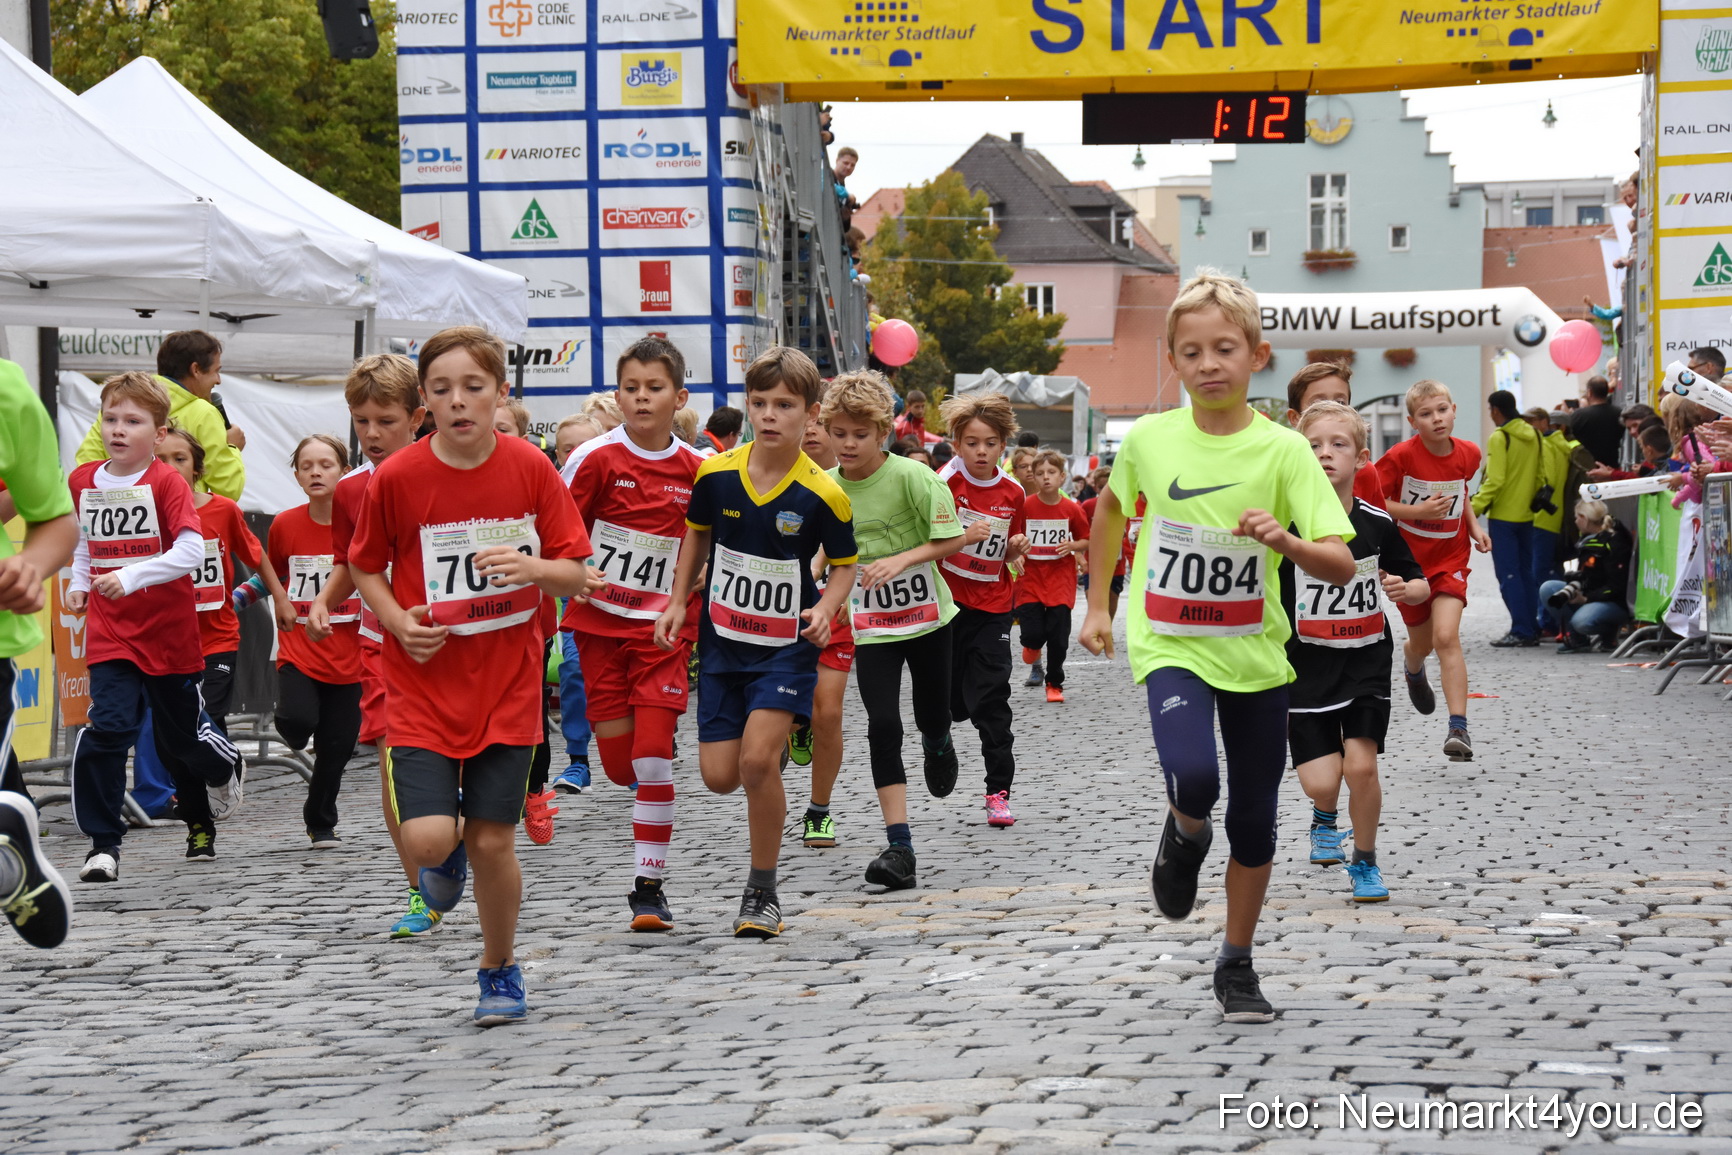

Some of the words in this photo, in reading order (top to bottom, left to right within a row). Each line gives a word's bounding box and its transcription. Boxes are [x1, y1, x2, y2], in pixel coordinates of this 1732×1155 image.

[538, 3, 570, 14] CODE
[1400, 6, 1512, 24] Neumarkter
[1515, 1, 1601, 19] Stadtlauf
[538, 14, 576, 26] CLINIC
[602, 12, 671, 24] RAIL.ONE
[786, 26, 890, 41] Neumarkter
[895, 24, 977, 40] Stadtlauf
[490, 75, 538, 86] Neumarkter
[539, 73, 573, 86] Tagblatt
[626, 65, 678, 87] Burgis
[1214, 96, 1290, 139] 1:12
[510, 146, 581, 160] VARIOTEC
[418, 161, 462, 174] energie
[656, 157, 702, 168] energie
[1694, 191, 1732, 205] VARI
[606, 208, 677, 224] charivari
[640, 289, 669, 303] Braun
[1261, 306, 1341, 330] BMW
[1351, 304, 1502, 334] Laufsport
[532, 366, 570, 374] neumarkt
[614, 479, 636, 488] JAKO
[1431, 482, 1459, 490] BOCK
[106, 489, 146, 501] BOCK
[722, 508, 740, 518] JAKO
[86, 506, 151, 537] 7022
[432, 538, 470, 548] NeuerMarkt
[476, 522, 530, 542] BOCK
[634, 534, 674, 551] BOCK
[1030, 529, 1066, 544] 7128
[93, 542, 151, 557] Jamie-Leon
[436, 544, 532, 594] 70
[598, 543, 667, 589] 7141
[749, 558, 795, 575] BOCK
[968, 559, 987, 573] Max
[1158, 546, 1258, 596] 7084
[606, 588, 643, 607] Julian
[720, 568, 793, 614] 7000
[1306, 578, 1377, 615] 7243
[468, 600, 512, 619] Julian
[1180, 605, 1224, 622] Attila
[730, 614, 768, 633] Niklas
[868, 610, 924, 626] Ferdinand
[1332, 624, 1362, 636] Leon
[785, 687, 798, 696] JAKO
